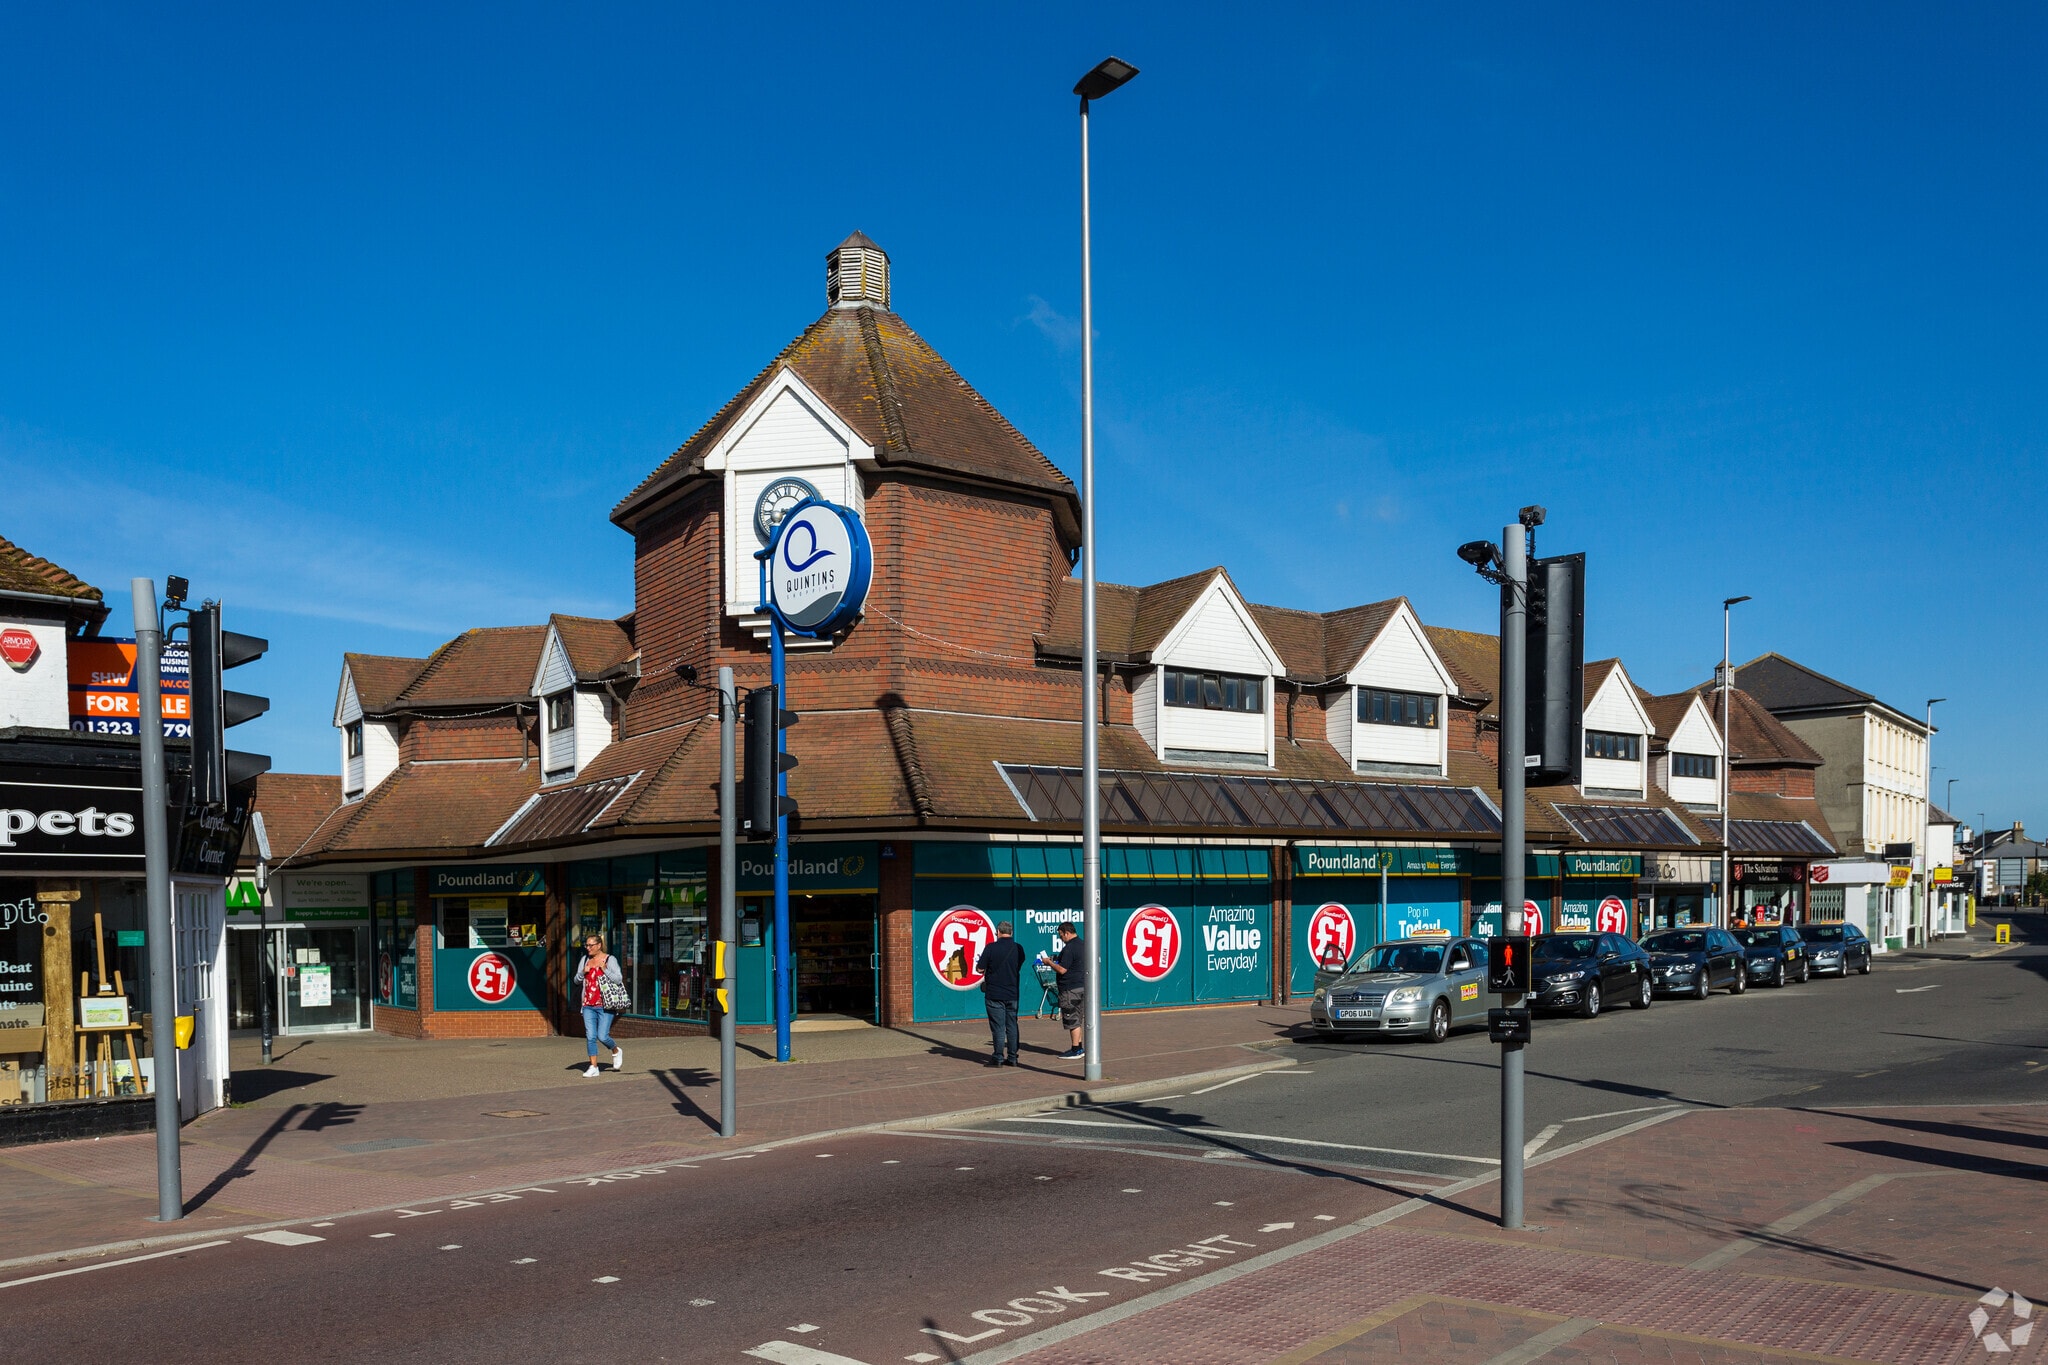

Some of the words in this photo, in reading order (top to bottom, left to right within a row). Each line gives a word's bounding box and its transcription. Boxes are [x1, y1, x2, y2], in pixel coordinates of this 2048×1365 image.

[786, 569, 834, 593] QUINTINS
[163, 650, 189, 658] ELOCA
[91, 671, 128, 684] SHW
[86, 695, 130, 713] FOR
[199, 840, 226, 864] Corner
[741, 859, 838, 875] Poudland
[1308, 853, 1376, 869] Poundland
[1406, 861, 1426, 870] Amazing
[1575, 859, 1621, 872] Poundland
[1744, 864, 1754, 873] The
[1754, 864, 1778, 873] Salvation
[438, 872, 514, 887] Poundland
[1025, 908, 1084, 924] Poundla
[1208, 905, 1255, 924] Amazing
[1407, 906, 1421, 919] Pop
[1422, 906, 1429, 916] in
[1563, 902, 1588, 914] Amazing
[951, 916, 977, 926] Poundland
[1561, 914, 1590, 926] Value
[1478, 921, 1493, 937] big
[1131, 920, 1172, 968] £1
[1202, 923, 1261, 952] Value
[939, 922, 987, 976] £1
[1207, 952, 1258, 973] Everyday!
[476, 963, 509, 996] £1
[920, 1285, 1109, 1344] LOOK
[1097, 1234, 1256, 1283] RIGHT
